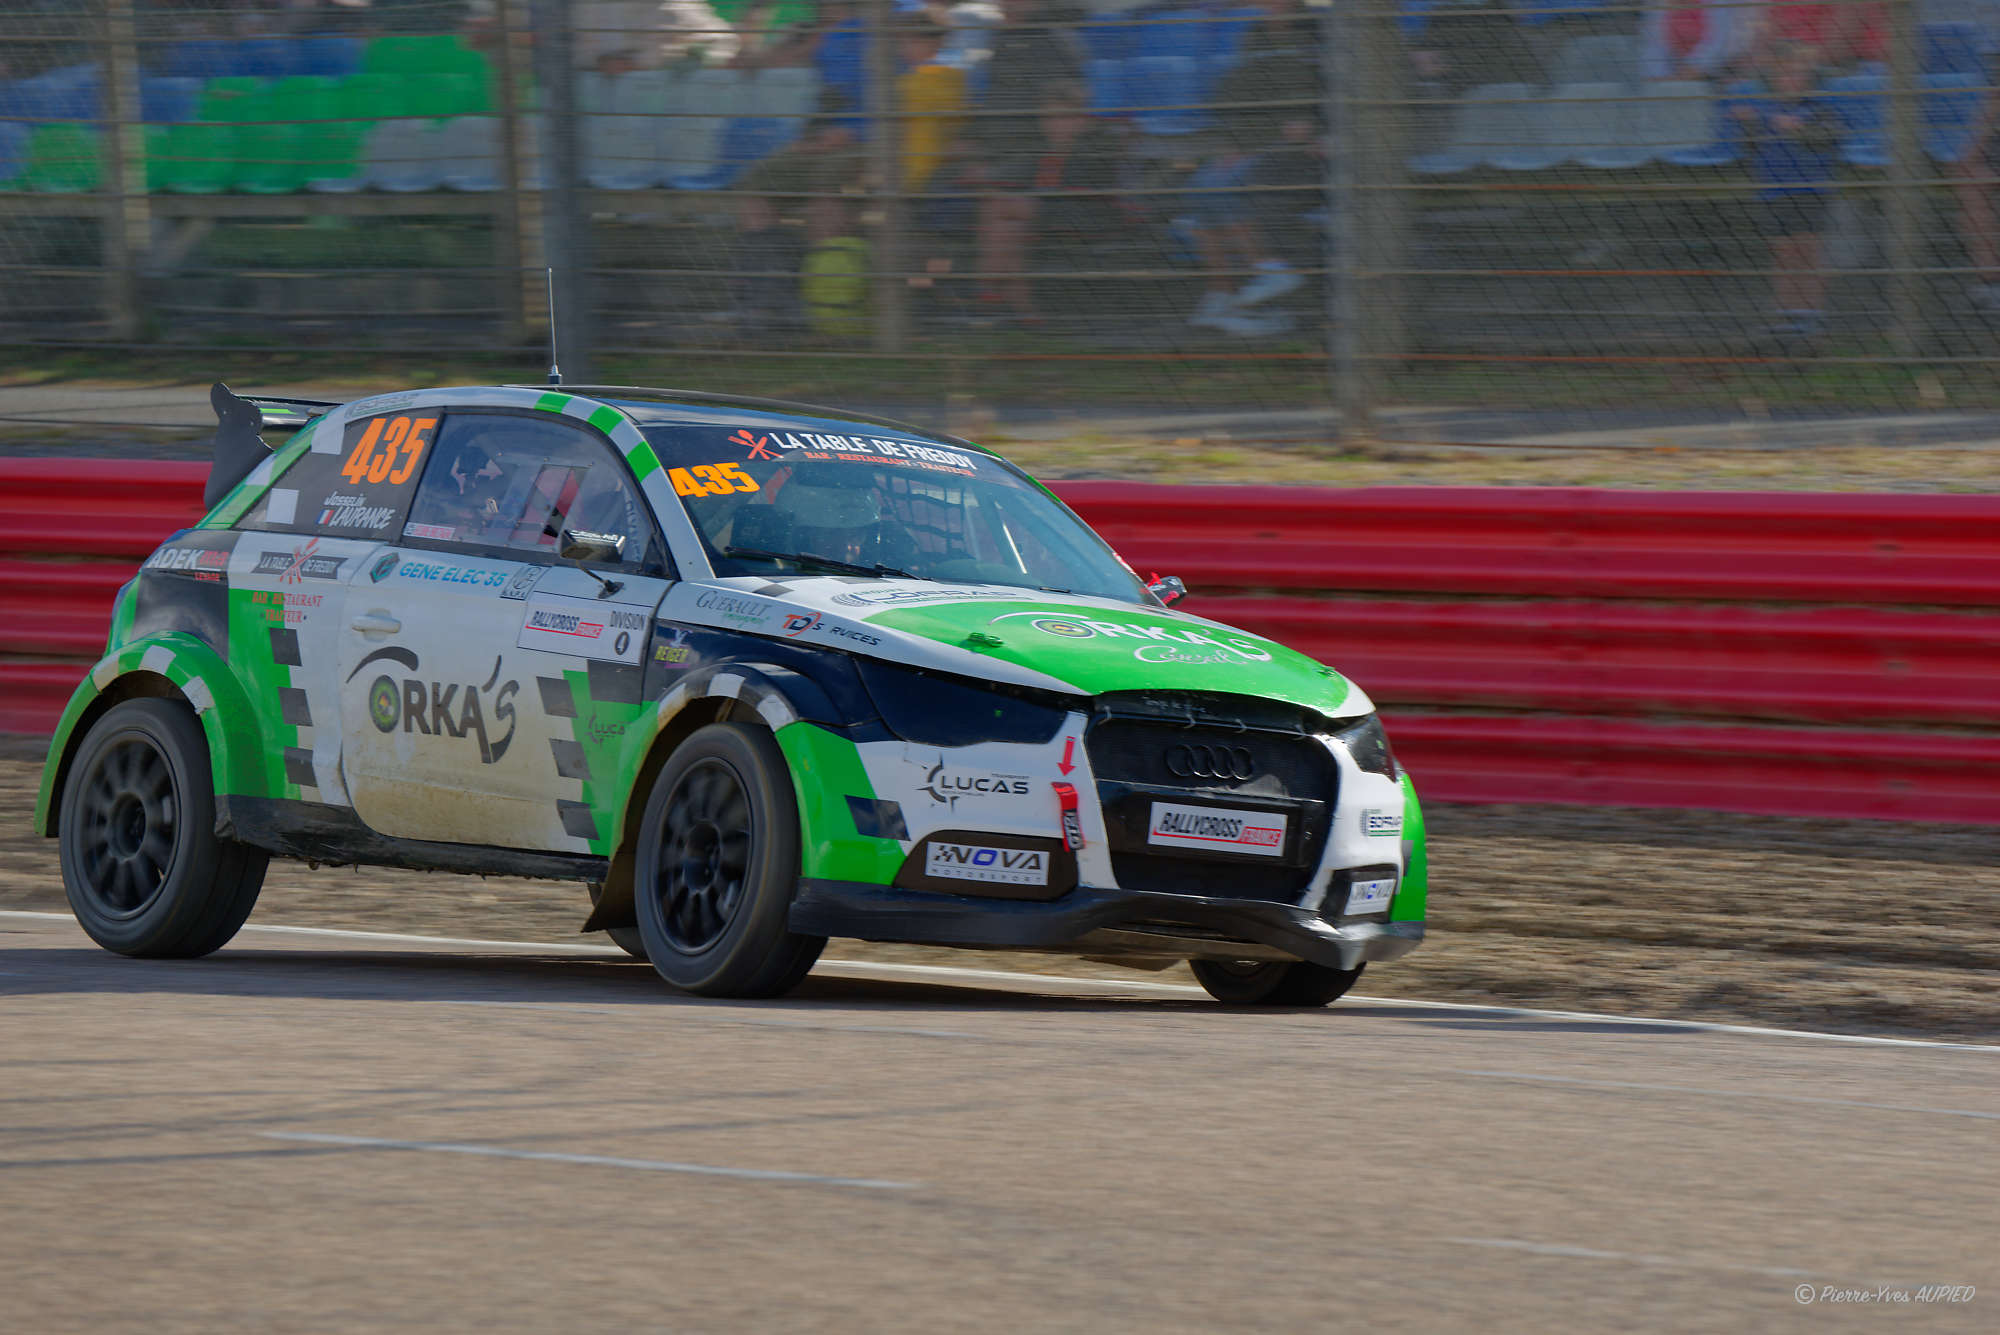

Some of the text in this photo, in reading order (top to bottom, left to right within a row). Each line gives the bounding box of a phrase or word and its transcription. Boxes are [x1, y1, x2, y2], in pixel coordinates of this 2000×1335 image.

[341, 417, 437, 484] 435
[769, 433, 978, 471] LA TABLE DE FREDDY
[804, 452, 832, 460] BAR
[667, 462, 760, 497] 435
[329, 507, 395, 529] LAURANCE
[400, 562, 445, 581] GENE
[441, 567, 486, 585] ELEC
[483, 571, 508, 587] 35
[531, 611, 580, 632] RALLYCROSS
[610, 610, 648, 631] DIVISION
[615, 631, 630, 655] 0
[369, 655, 520, 764] ORKA'S
[941, 775, 1030, 796] LUCAS
[1160, 811, 1243, 838] RALLYCROSS
